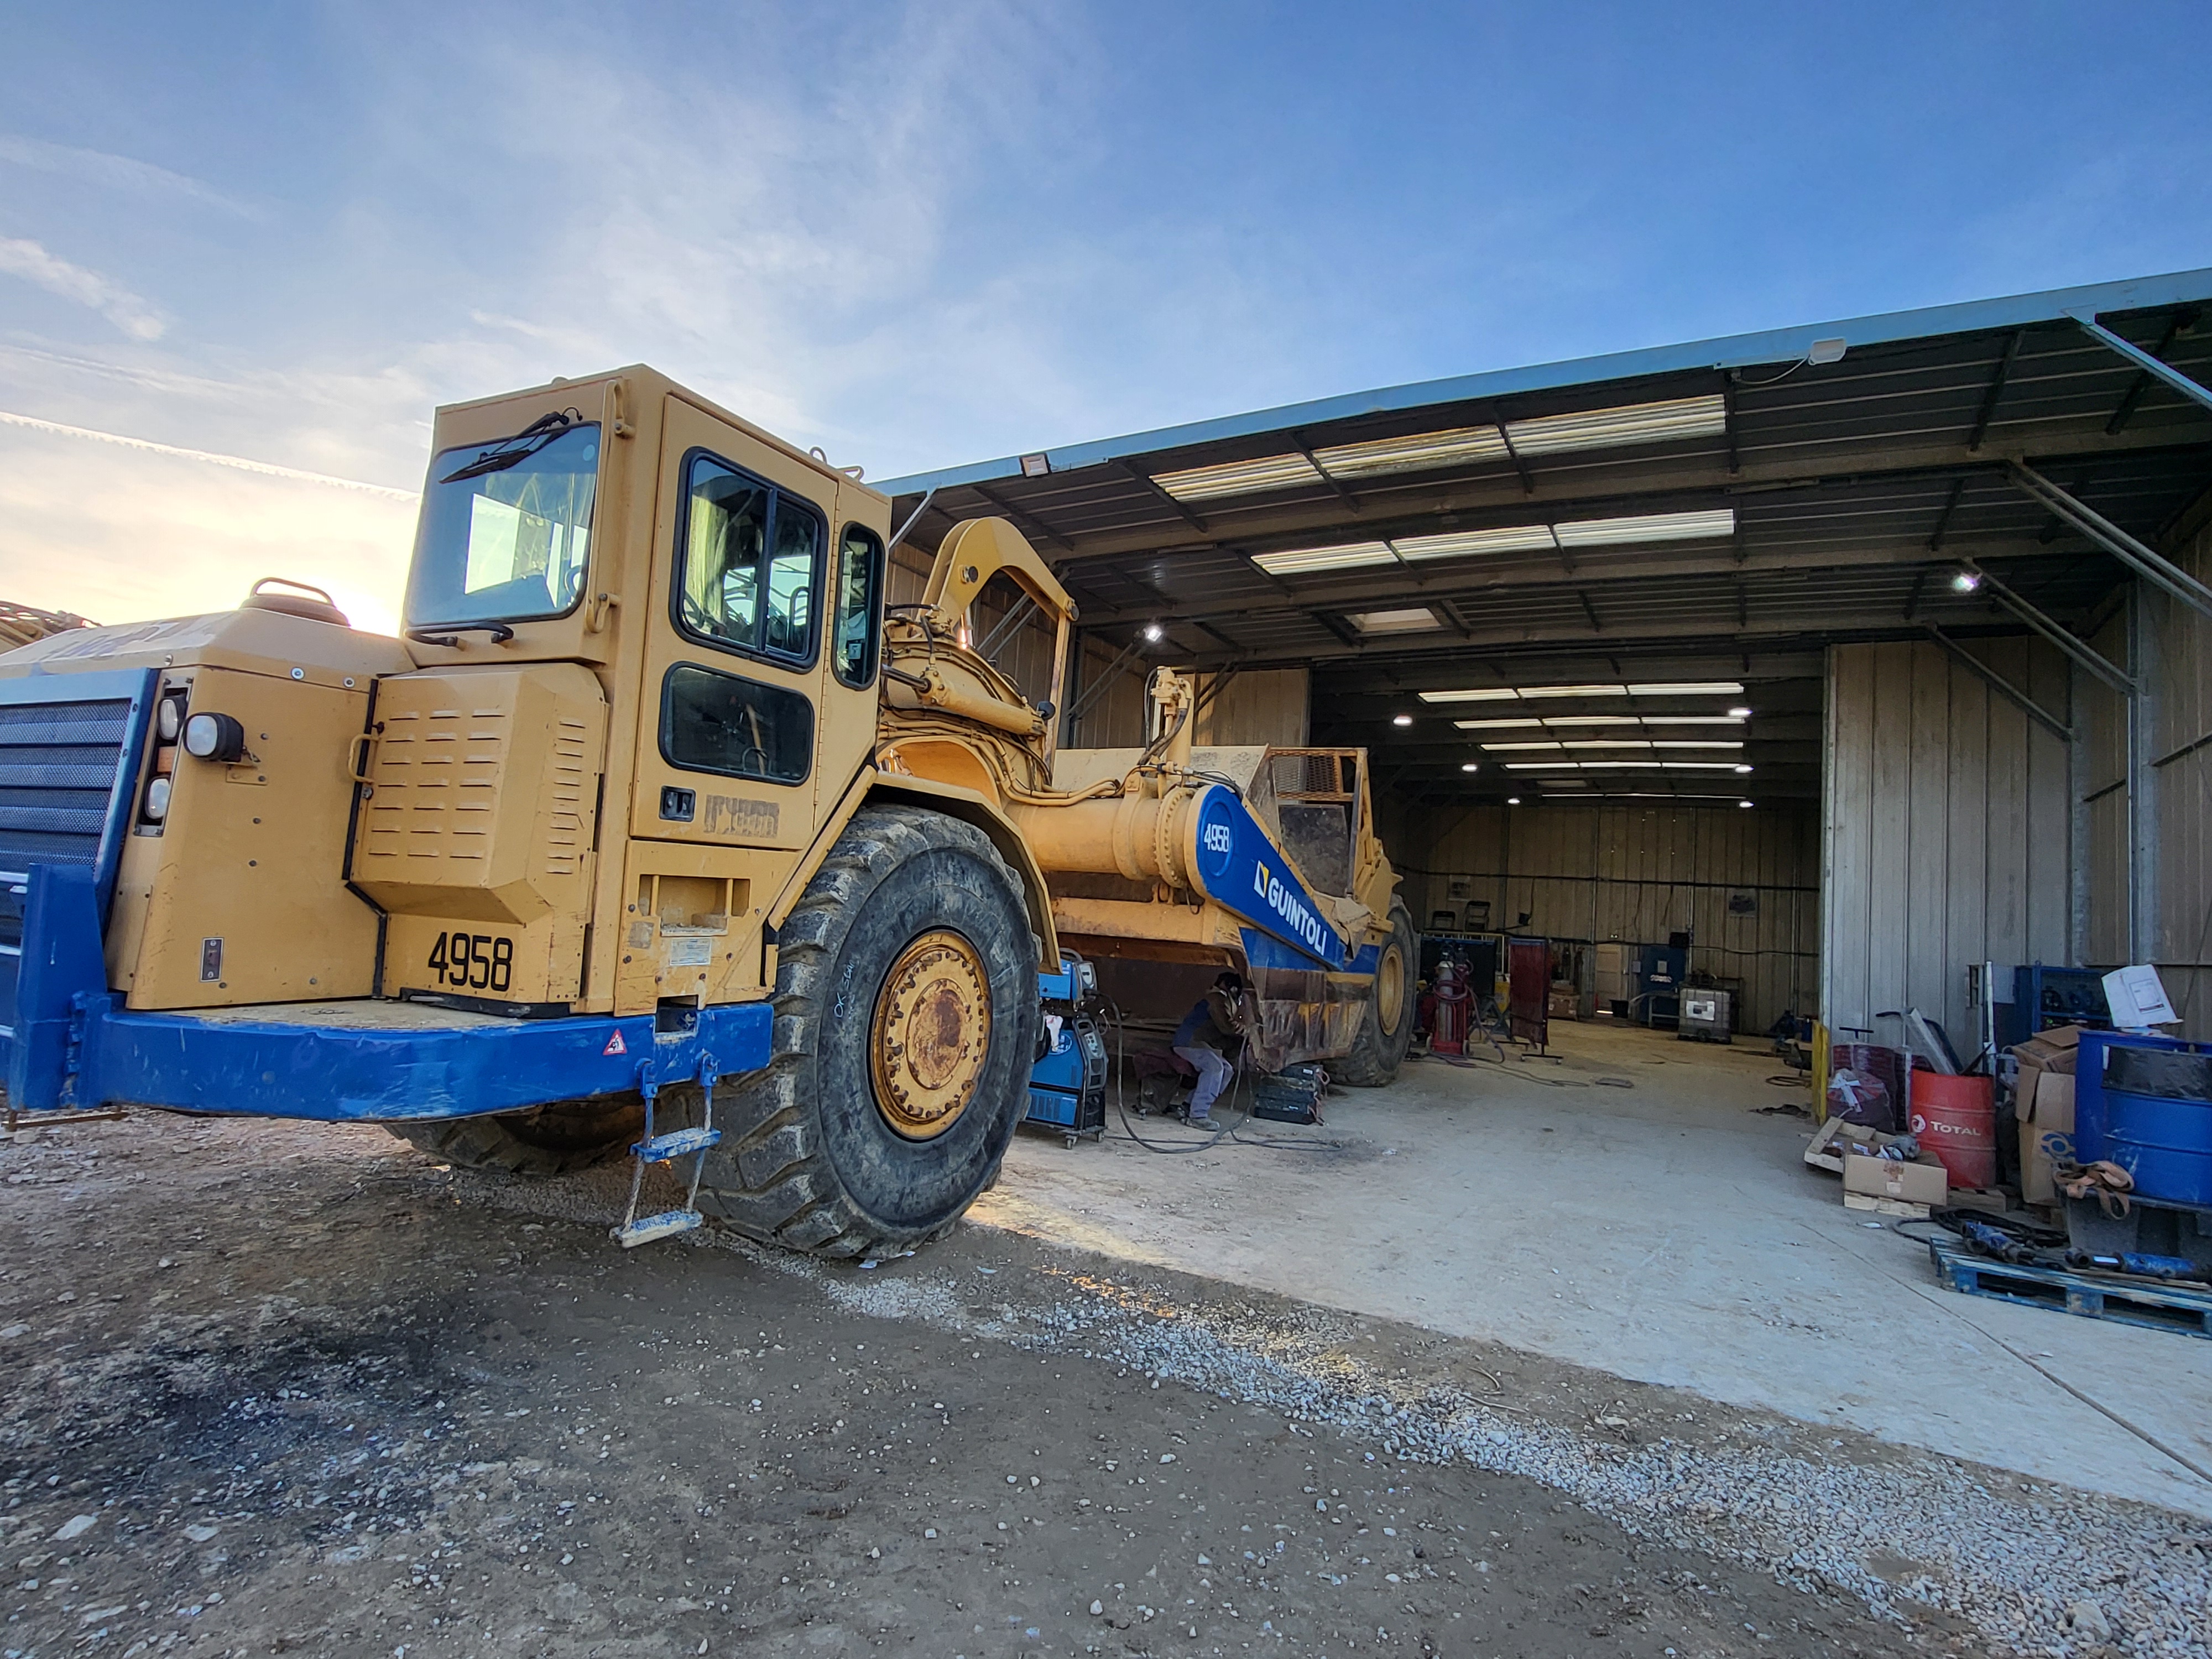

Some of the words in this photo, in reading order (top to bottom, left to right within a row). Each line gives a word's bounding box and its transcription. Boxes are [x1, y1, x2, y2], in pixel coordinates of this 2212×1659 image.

[1204, 823, 1229, 852] 4958
[1268, 877, 1327, 956] GUINTOLI
[428, 931, 513, 992] 4958
[1930, 1121, 1981, 1135] TOTAL
